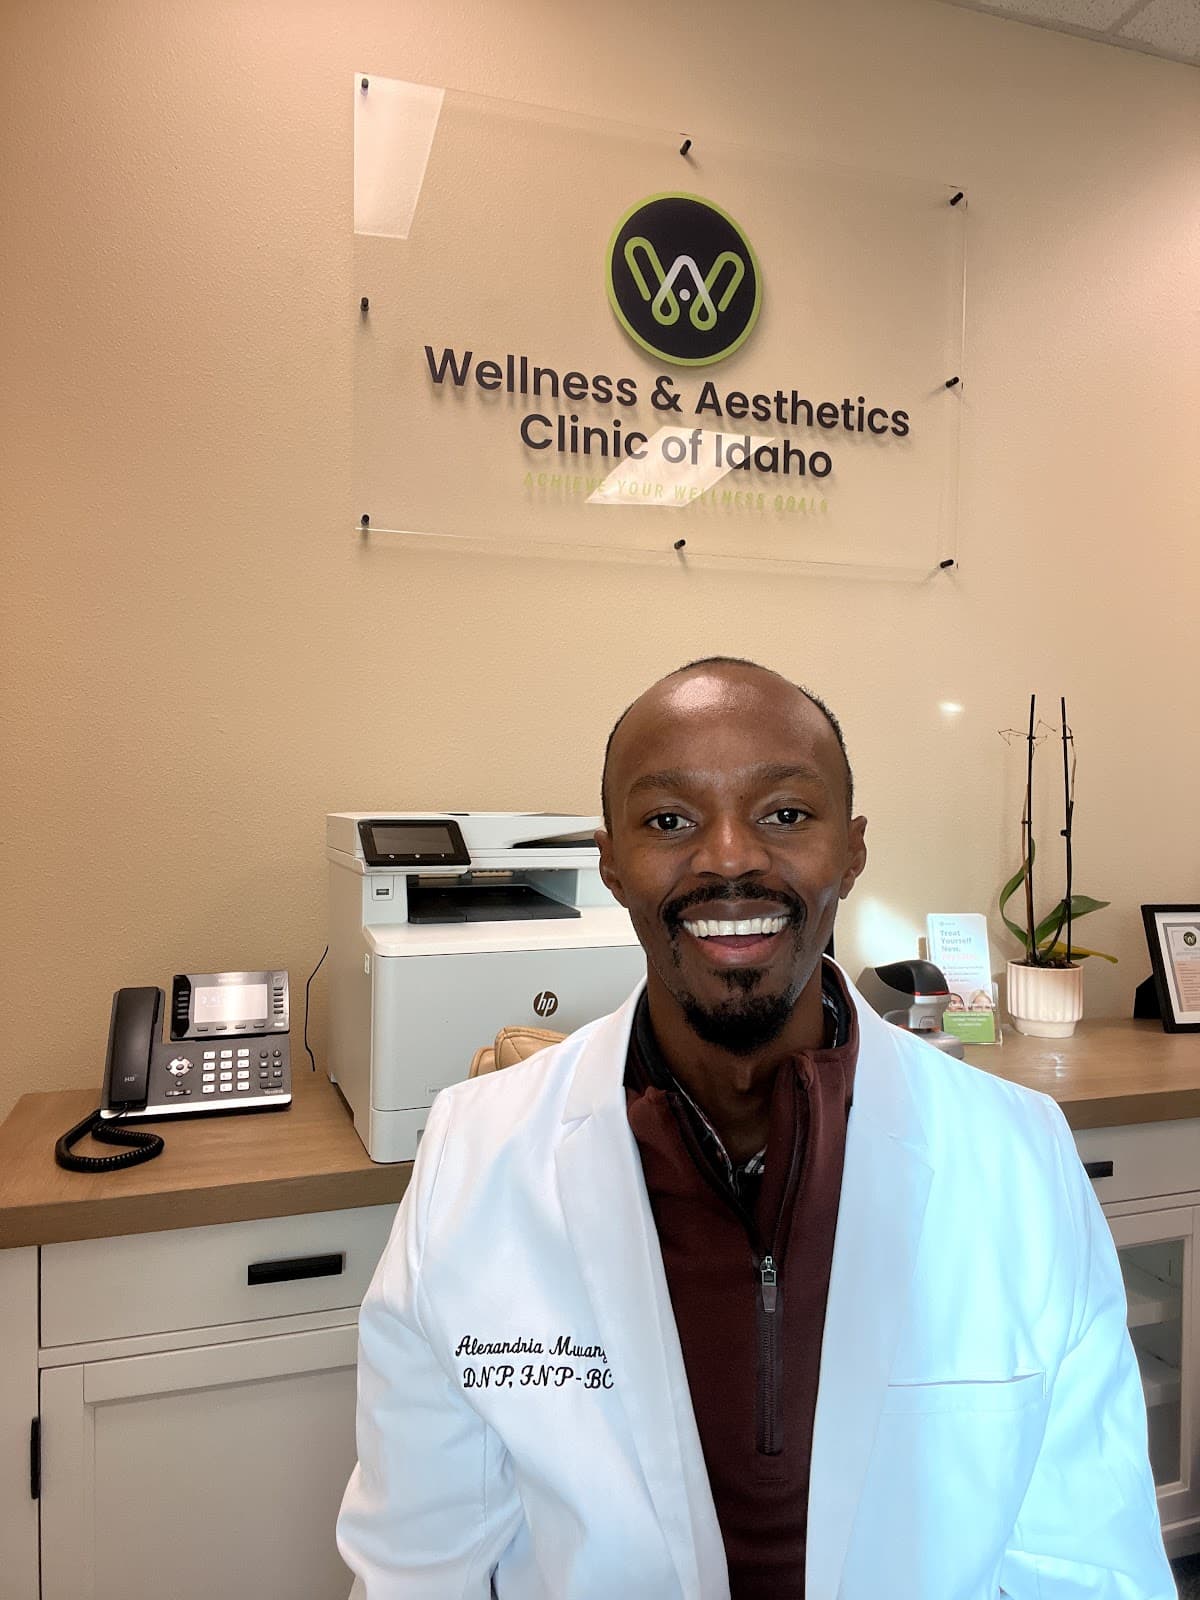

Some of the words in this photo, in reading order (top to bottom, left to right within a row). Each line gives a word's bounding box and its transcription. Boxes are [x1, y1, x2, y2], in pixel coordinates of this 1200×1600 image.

[424, 345, 637, 407] Wellness
[650, 375, 683, 413] &
[694, 381, 910, 437] Aesthetics
[520, 413, 649, 460] Clinic
[661, 428, 703, 465] of
[715, 433, 833, 478] Idaho
[523, 471, 606, 493] ACHIEVE
[616, 479, 664, 498] YOUR
[674, 484, 768, 512] WELLNESS
[774, 493, 830, 513] GOALS
[536, 991, 556, 1017] hp
[455, 1335, 544, 1357] Alexandria
[463, 1365, 515, 1389] DNP,
